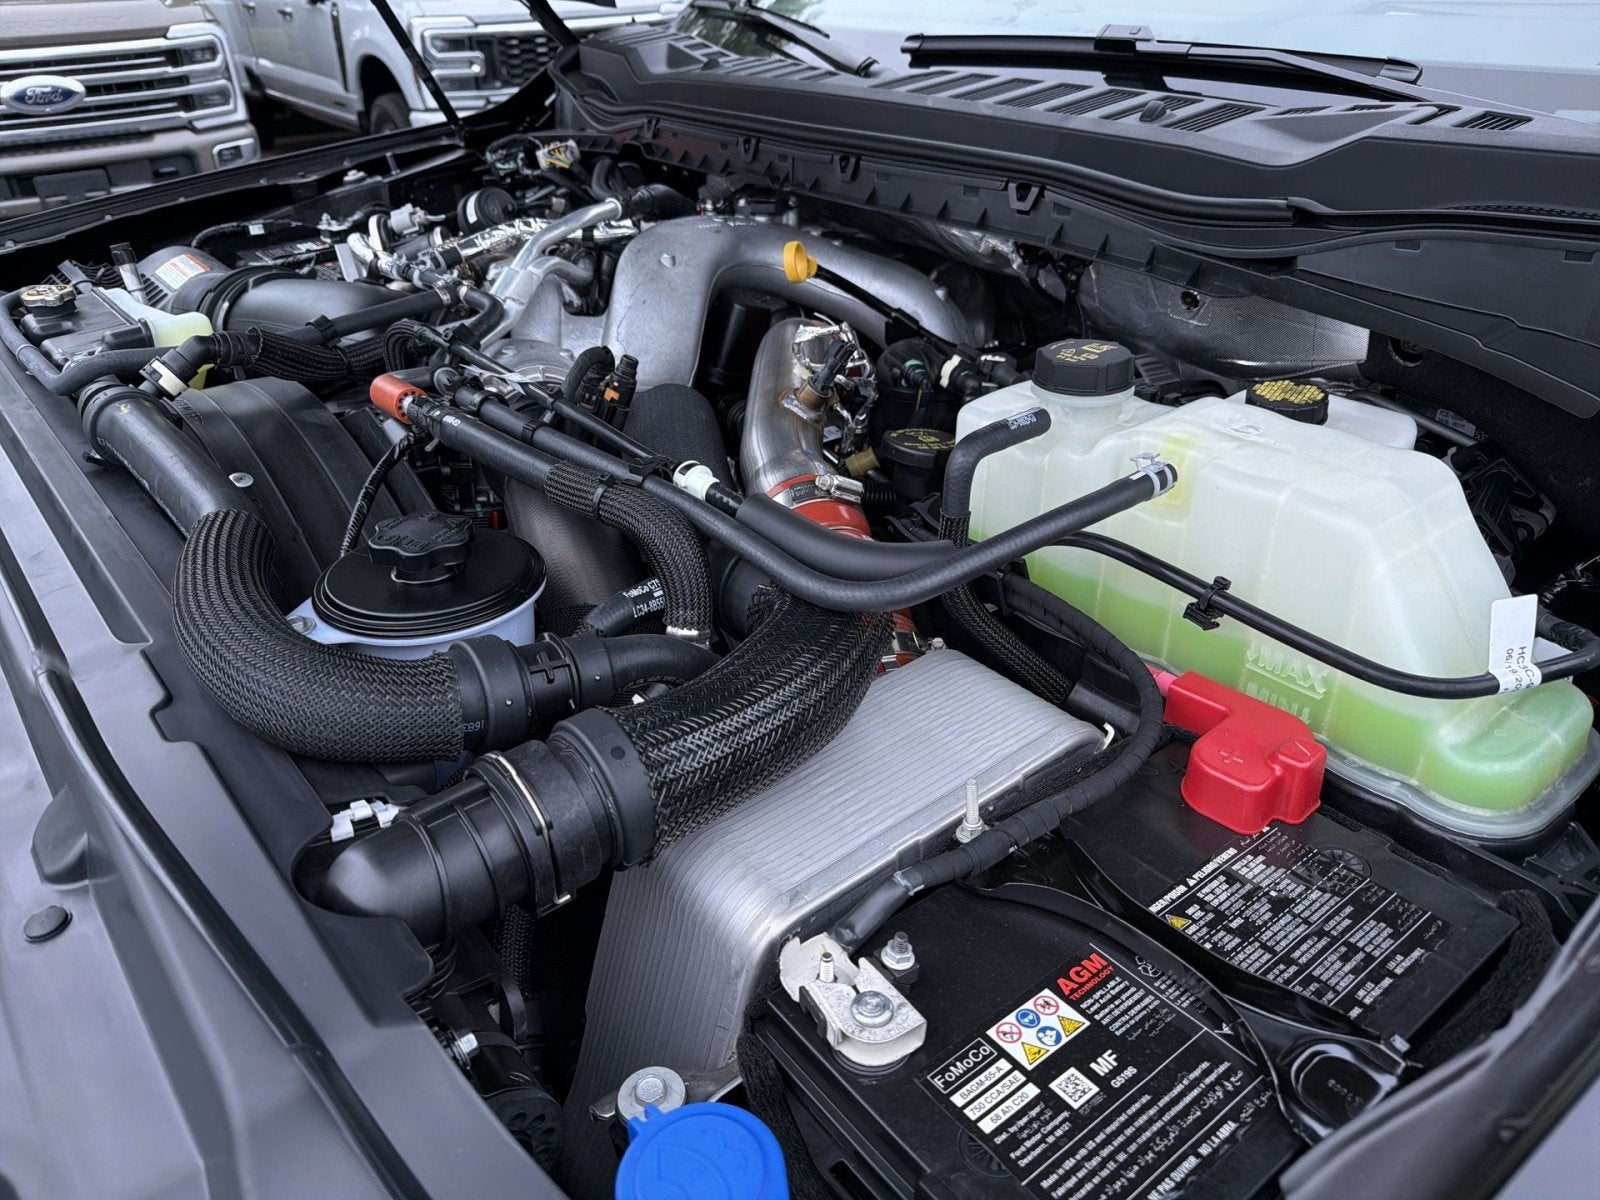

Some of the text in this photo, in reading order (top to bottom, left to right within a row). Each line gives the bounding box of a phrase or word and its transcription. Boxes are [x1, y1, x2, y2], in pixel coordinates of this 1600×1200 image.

[23, 86, 64, 106] Ford
[1253, 644, 1333, 695] MAX
[1148, 882, 1188, 914] NGER/POISON
[1051, 951, 1108, 996] AGM
[1069, 964, 1116, 1002] TECHNOLOGY
[1079, 975, 1122, 1009] NON-SPILLABLE
[1096, 993, 1112, 1005] Acid
[1108, 979, 1131, 996] Battery
[1093, 1002, 1116, 1021] Batterie
[1100, 1013, 1115, 1026] ANTI
[1107, 1013, 1131, 1032] CONTRA
[933, 1041, 992, 1090] FoMoCo
[1088, 1048, 1123, 1077] MF
[959, 1064, 1004, 1101] BAGM-65-A
[968, 1073, 1021, 1116] 750 CCA/SAE
[989, 1090, 1030, 1125] 68 Ah C20
[1134, 1118, 1165, 1144] materiales
[1201, 1058, 1233, 1086] importados.
[1009, 1144, 1027, 1161] Ford
[1023, 1130, 1044, 1149] Motor
[1038, 1171, 1059, 1189] Made
[1054, 1166, 1066, 1176] in
[1060, 1155, 1078, 1171] USA
[1072, 1146, 1089, 1160] with
[1083, 1139, 1097, 1151] US
[1092, 1130, 1107, 1143] and
[1102, 1112, 1129, 1135] imported
[1124, 1091, 1153, 1116] materials.
[1045, 1133, 1057, 1144] MI
[1049, 1174, 1079, 1200] Fabriqué
[1074, 1166, 1089, 1178] aux
[1110, 1132, 1127, 1147] avec
[1122, 1123, 1137, 1136] des
[1181, 1077, 1191, 1085] et
[1196, 1142, 1213, 1157] NO
[1205, 1134, 1222, 1148] LA
[1155, 1176, 1176, 1195] PAS
